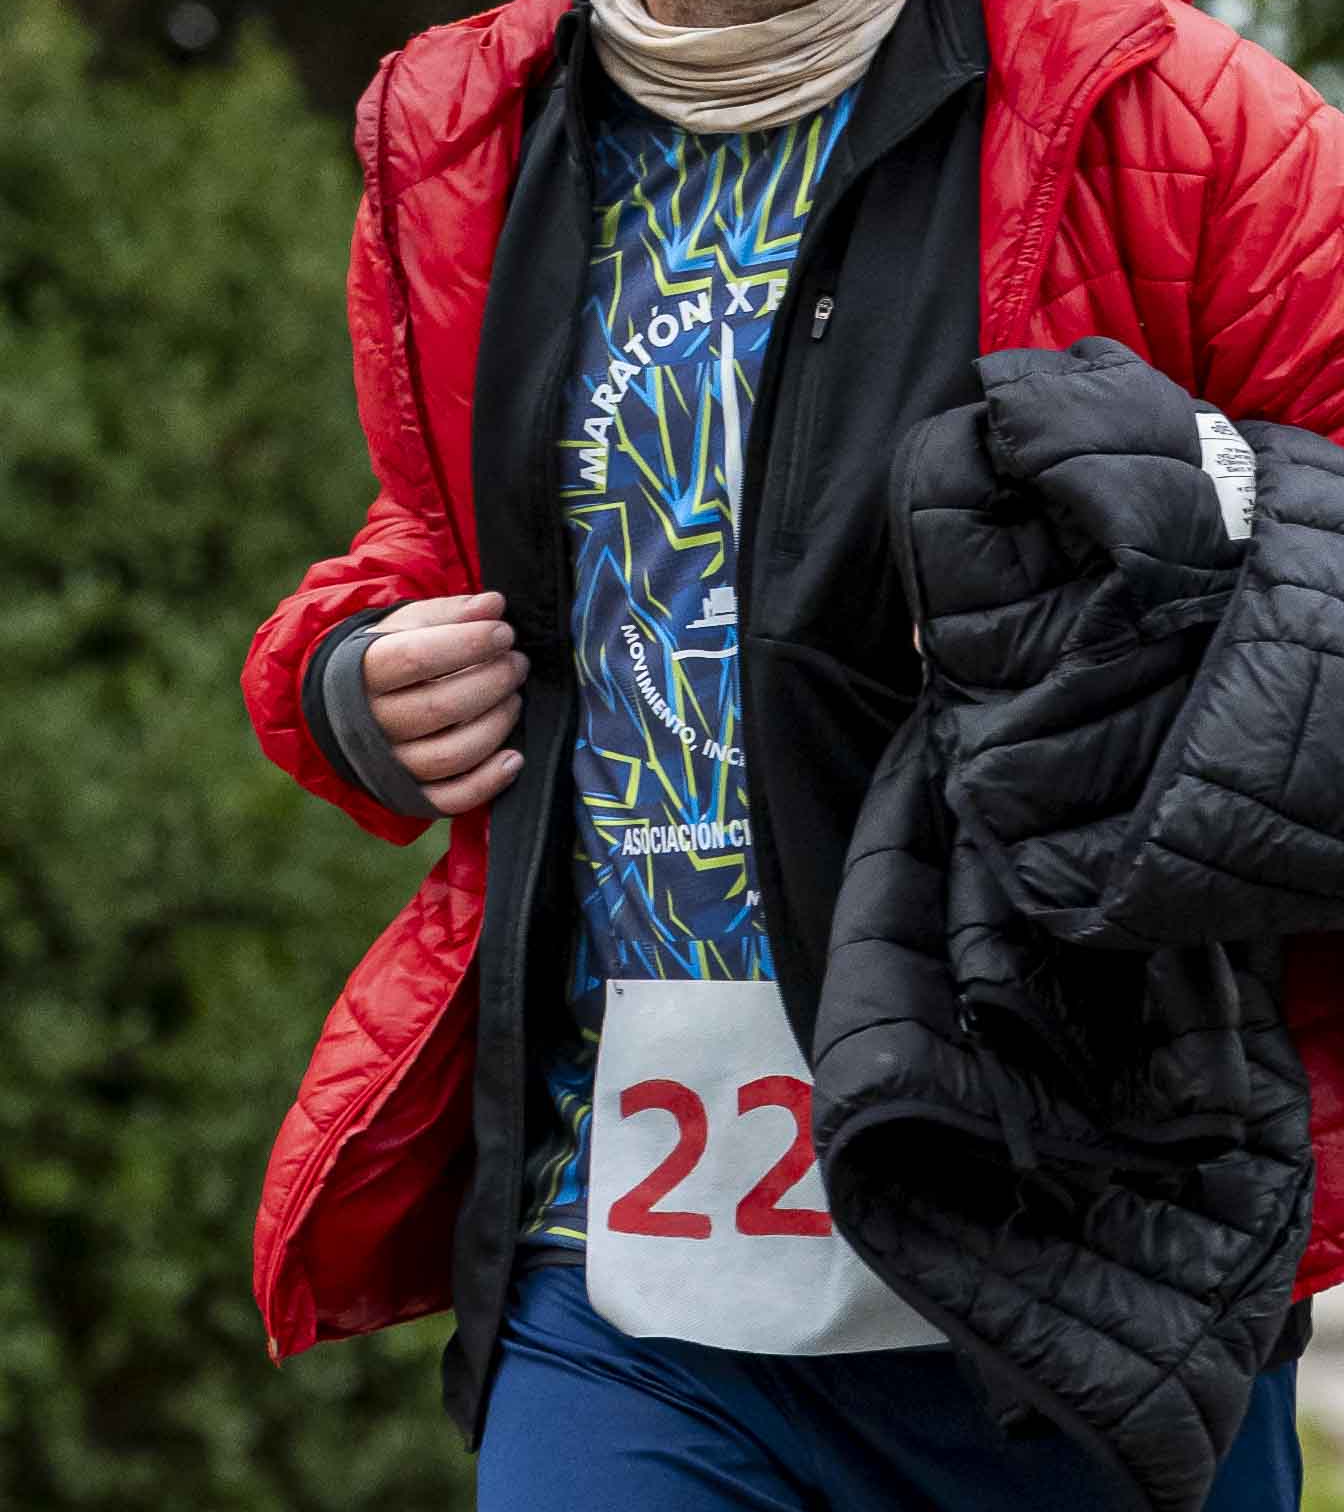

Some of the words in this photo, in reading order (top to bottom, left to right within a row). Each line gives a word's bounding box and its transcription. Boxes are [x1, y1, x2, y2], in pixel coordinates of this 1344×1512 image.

[579, 292, 713, 489] MARATÓN
[724, 280, 753, 315] X
[767, 278, 788, 311] E
[621, 624, 698, 751] MOVIMIENTO,
[702, 739, 745, 767] INC
[622, 814, 725, 856] ASOCIACIÓN
[729, 819, 752, 847] CI
[608, 1075, 833, 1240] 22
